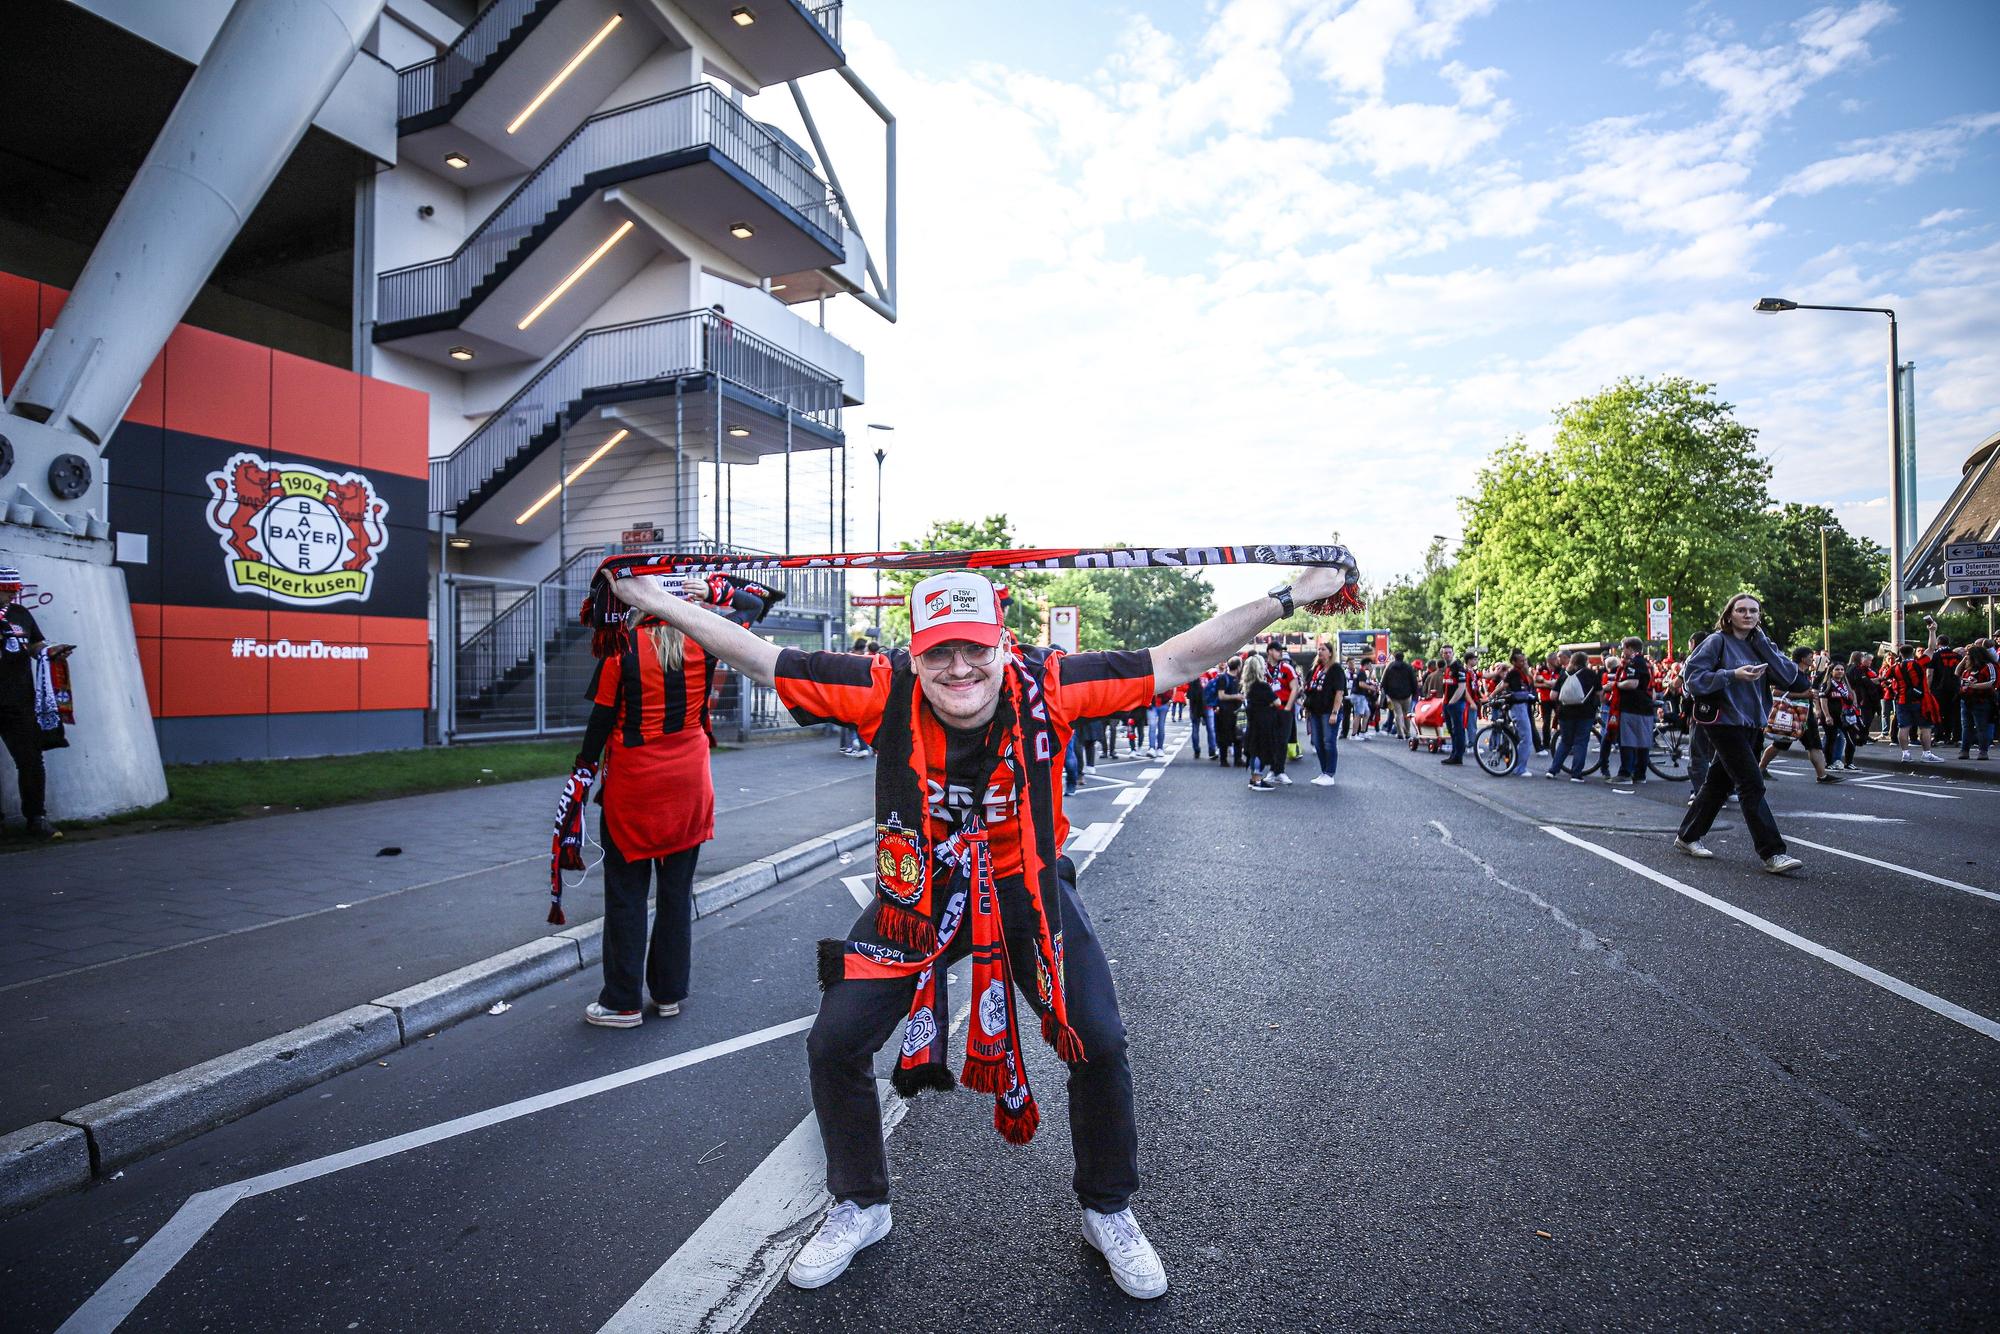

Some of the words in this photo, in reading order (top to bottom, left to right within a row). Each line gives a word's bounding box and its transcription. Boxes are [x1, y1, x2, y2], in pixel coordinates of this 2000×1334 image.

[285, 476, 322, 494] 1904
[270, 526, 337, 545] BAYER
[298, 502, 311, 569] BAYER
[245, 565, 356, 594] Leverkusen
[952, 594, 977, 603] Bayer
[231, 637, 369, 660] #ForOurDream
